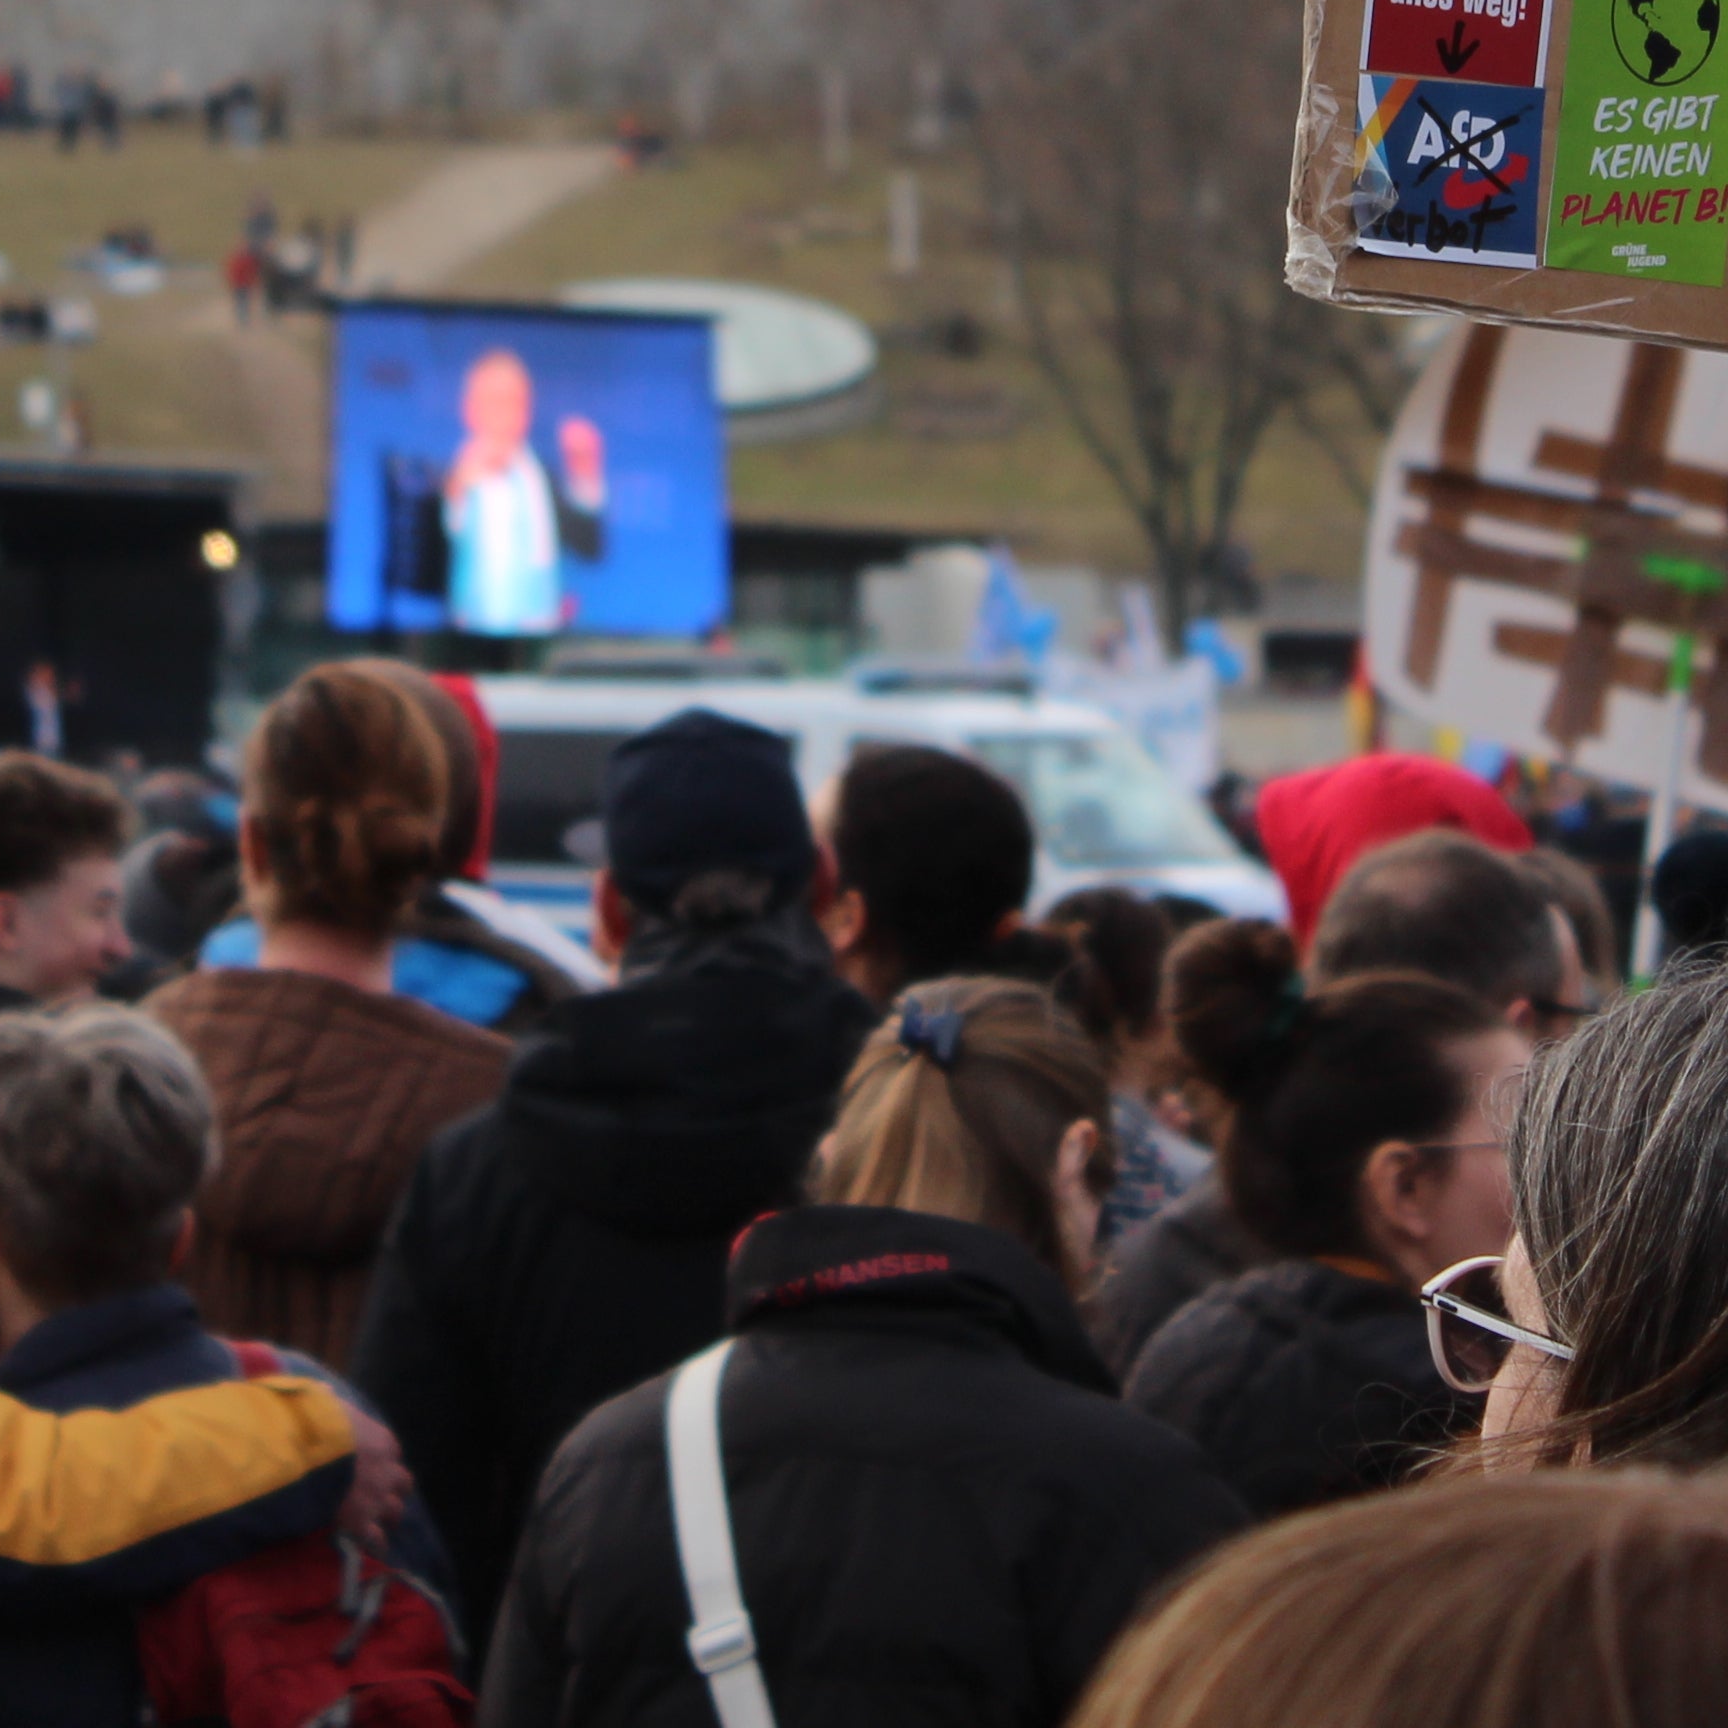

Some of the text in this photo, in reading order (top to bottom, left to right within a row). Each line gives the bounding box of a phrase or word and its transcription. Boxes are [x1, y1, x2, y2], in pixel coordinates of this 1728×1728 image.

[1594, 94, 1719, 135] ES GIBT
[1590, 142, 1711, 179] KEINEN
[1560, 187, 1691, 227] PLANET
[1612, 243, 1647, 256] GRÜNE
[1627, 255, 1666, 267] JUGEND
